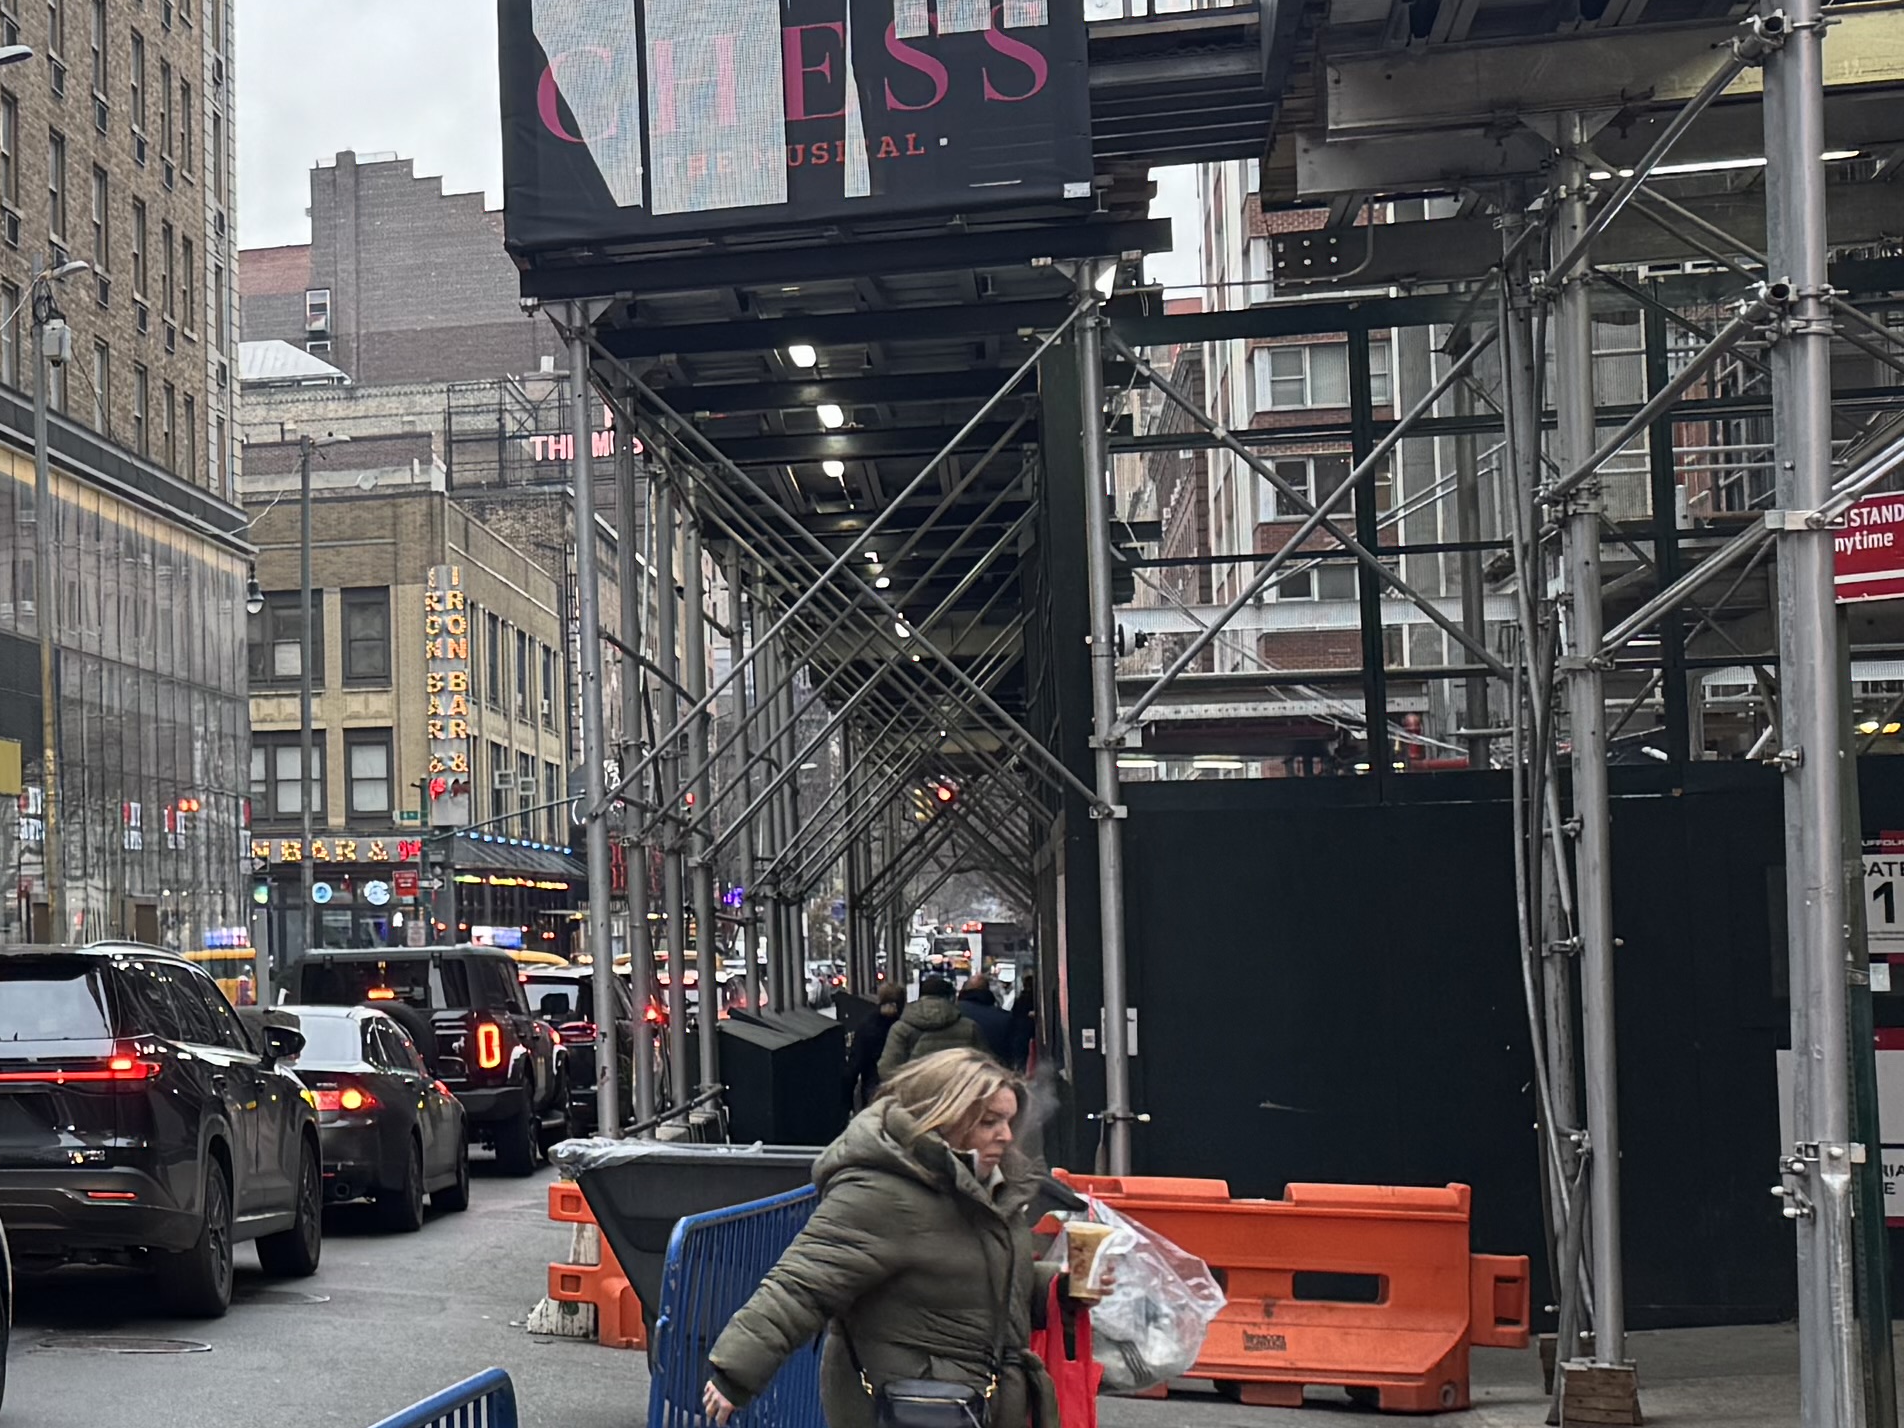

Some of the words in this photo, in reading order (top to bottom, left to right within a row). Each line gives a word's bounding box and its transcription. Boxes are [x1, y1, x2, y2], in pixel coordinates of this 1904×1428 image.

[754, 132, 926, 172] MUSIAL
[1834, 530, 1894, 556] nytime
[446, 565, 468, 660] IRON
[447, 672, 469, 739] BAR
[280, 839, 357, 862] BAR
[1873, 881, 1896, 925] 1
